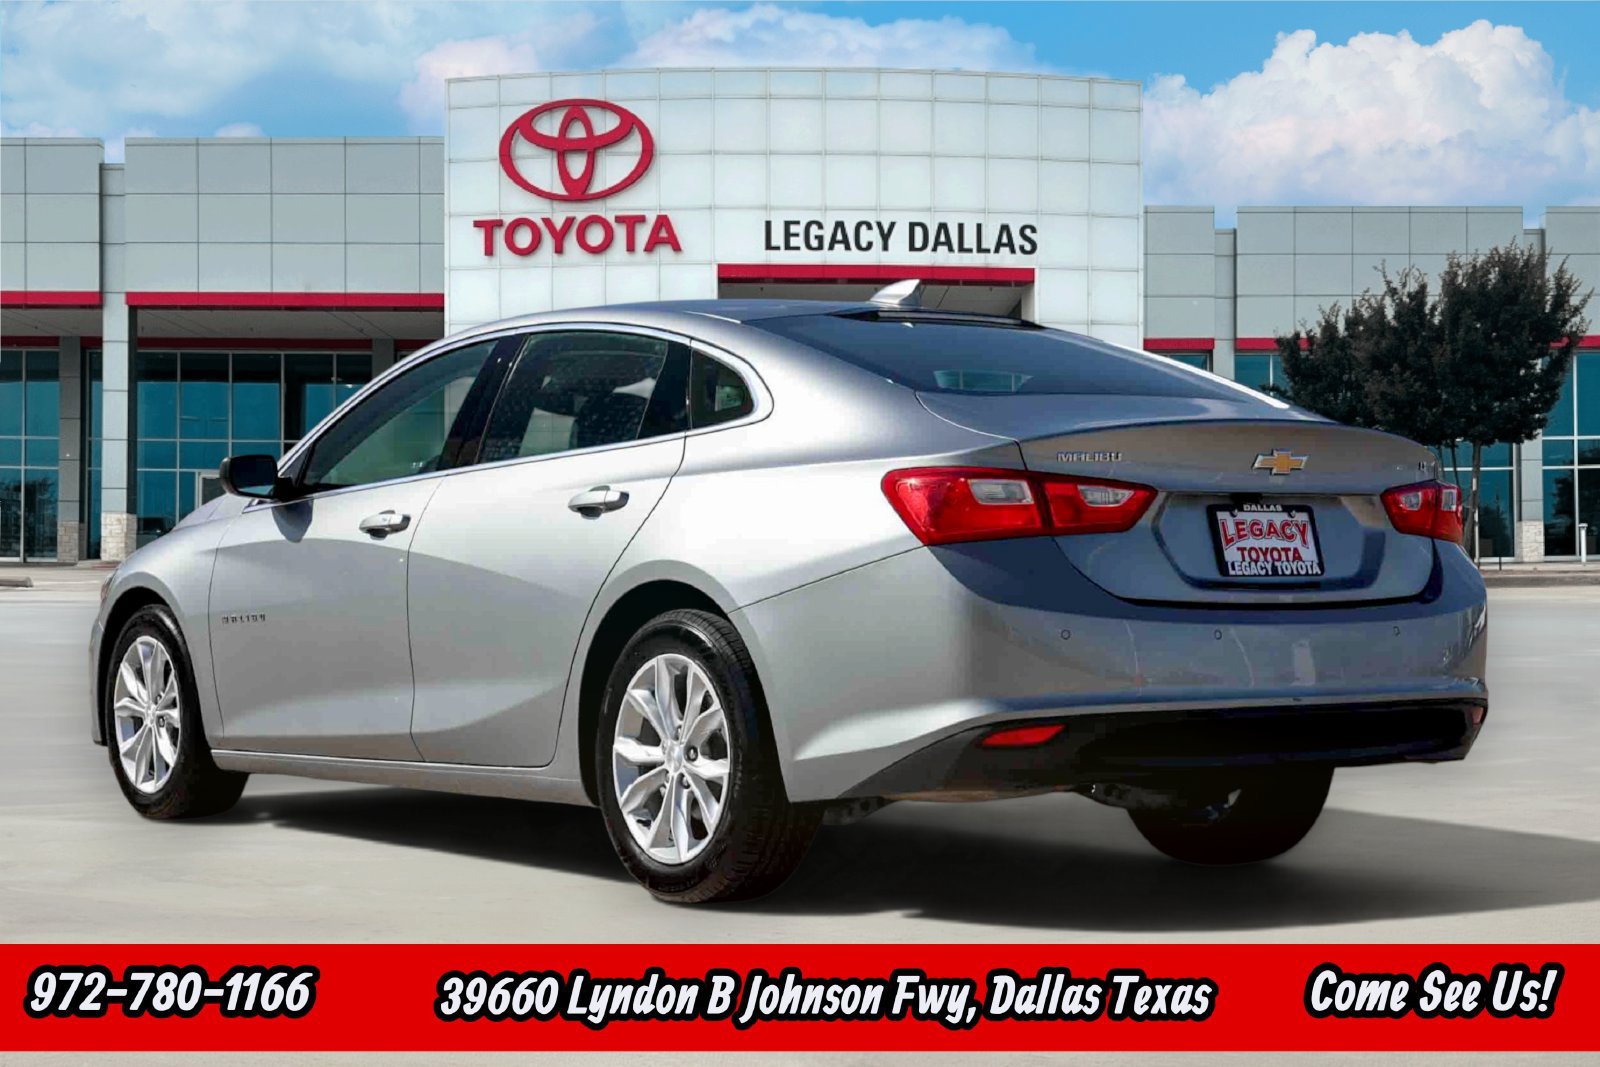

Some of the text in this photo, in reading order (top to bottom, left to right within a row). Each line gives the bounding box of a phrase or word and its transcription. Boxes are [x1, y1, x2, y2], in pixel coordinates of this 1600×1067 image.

[473, 213, 682, 257] TOYOTA
[764, 219, 1038, 255] LEGACY DALLAS
[1056, 451, 1123, 463] MALIBU
[1242, 504, 1283, 512] DALLAS
[1219, 518, 1310, 550] LEGACY
[1236, 546, 1303, 562] TOYOTA
[1227, 560, 1322, 576] LEGACY TOYOTA
